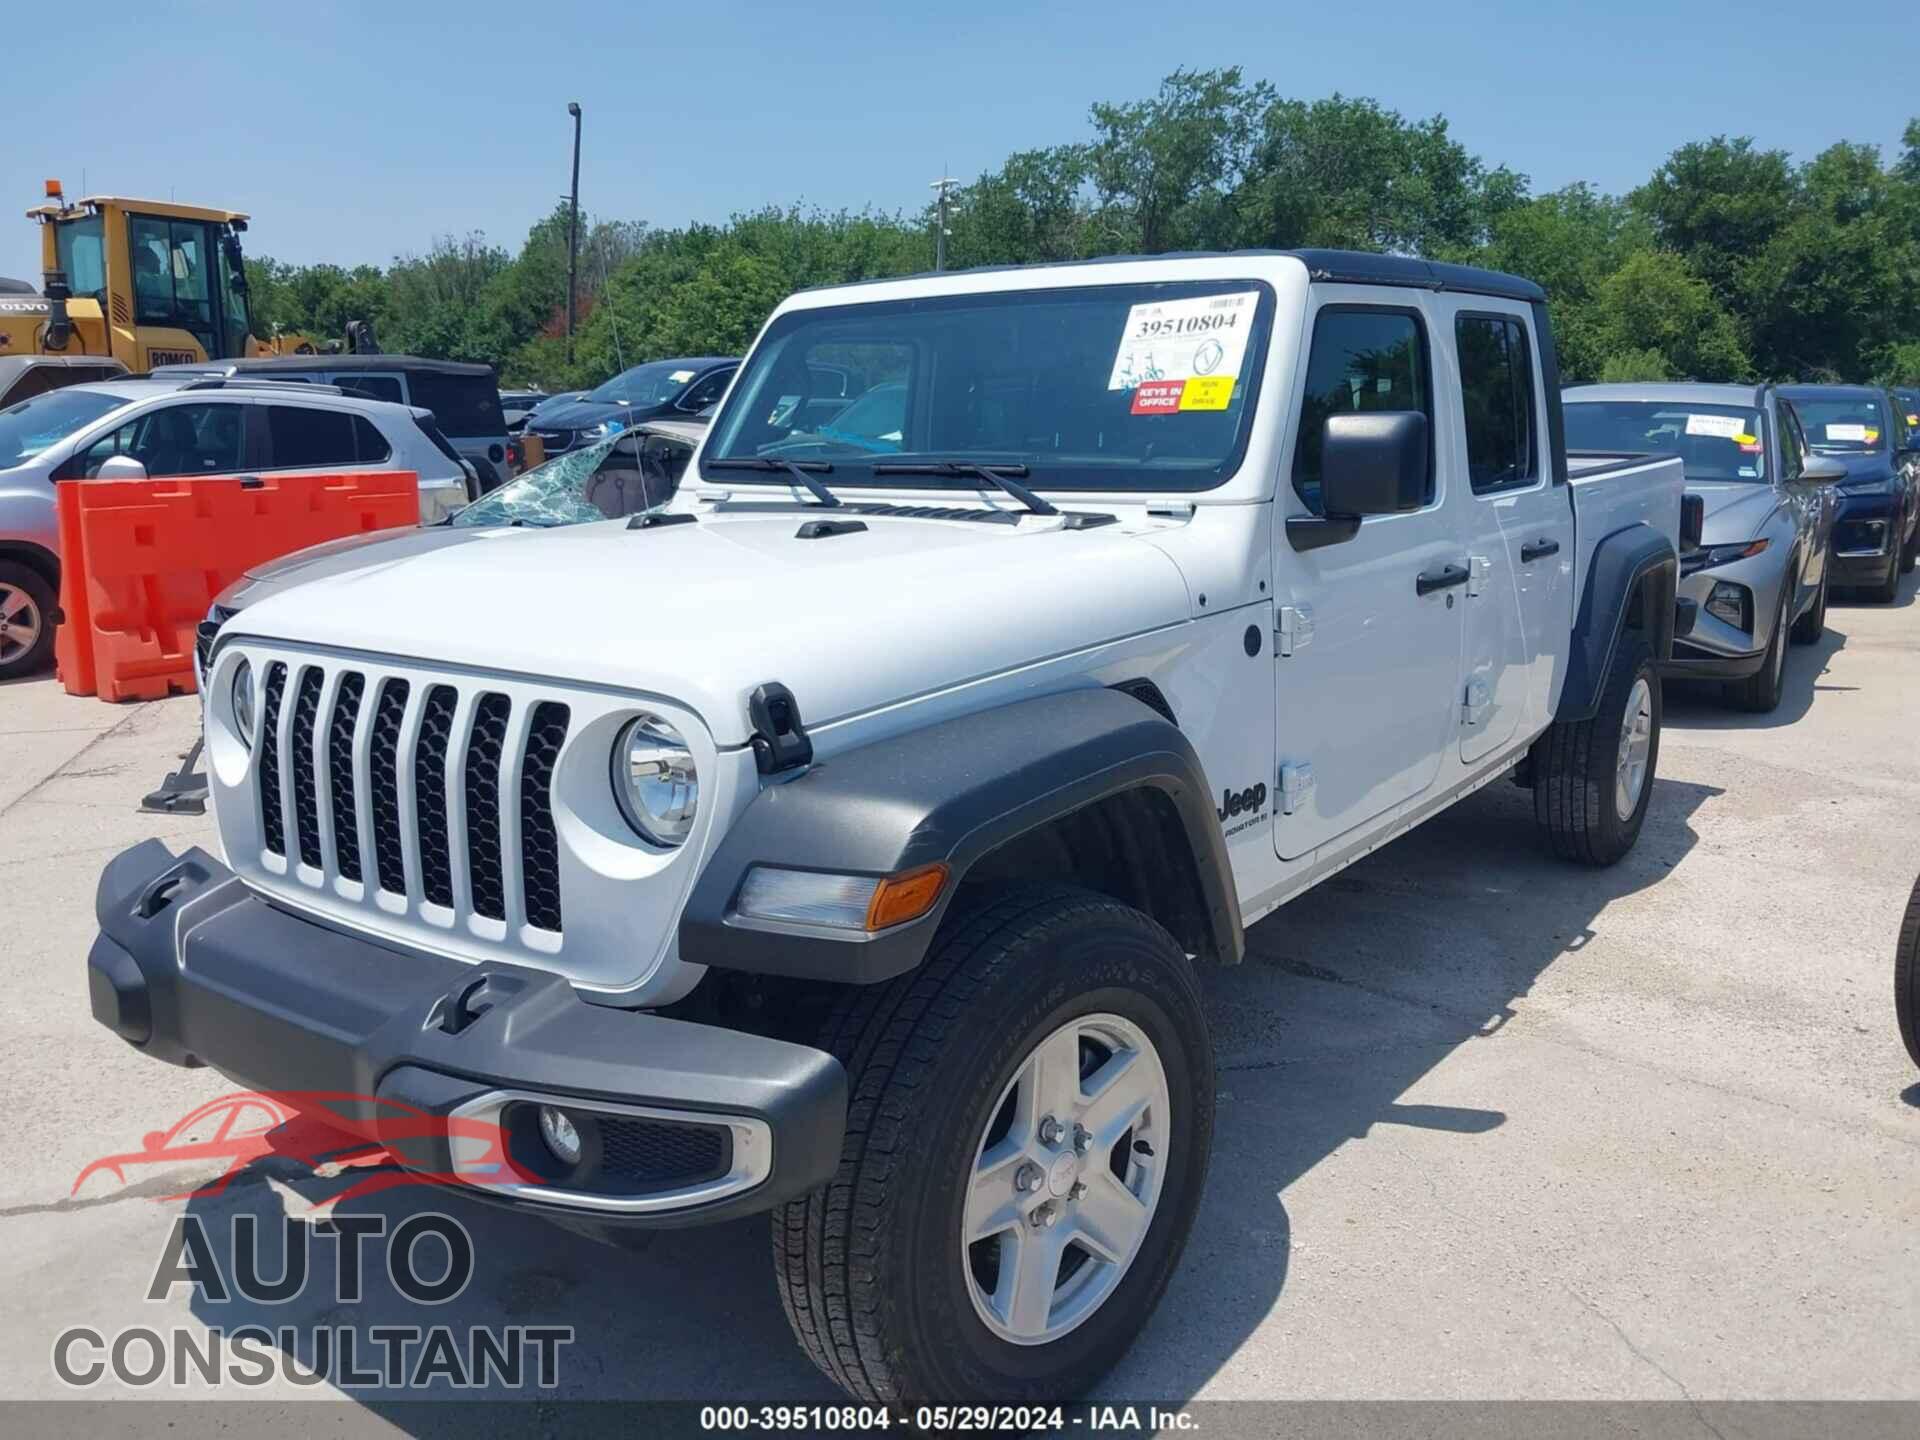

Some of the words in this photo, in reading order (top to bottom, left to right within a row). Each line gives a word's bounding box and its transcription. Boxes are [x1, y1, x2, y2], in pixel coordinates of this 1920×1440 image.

[0, 303, 49, 311] OLVO
[1136, 312, 1237, 339] 39510804
[1139, 386, 1168, 397] KEYS
[1170, 386, 1182, 396] IN
[1139, 397, 1176, 407] OFFICE
[1217, 782, 1266, 822] Jeep
